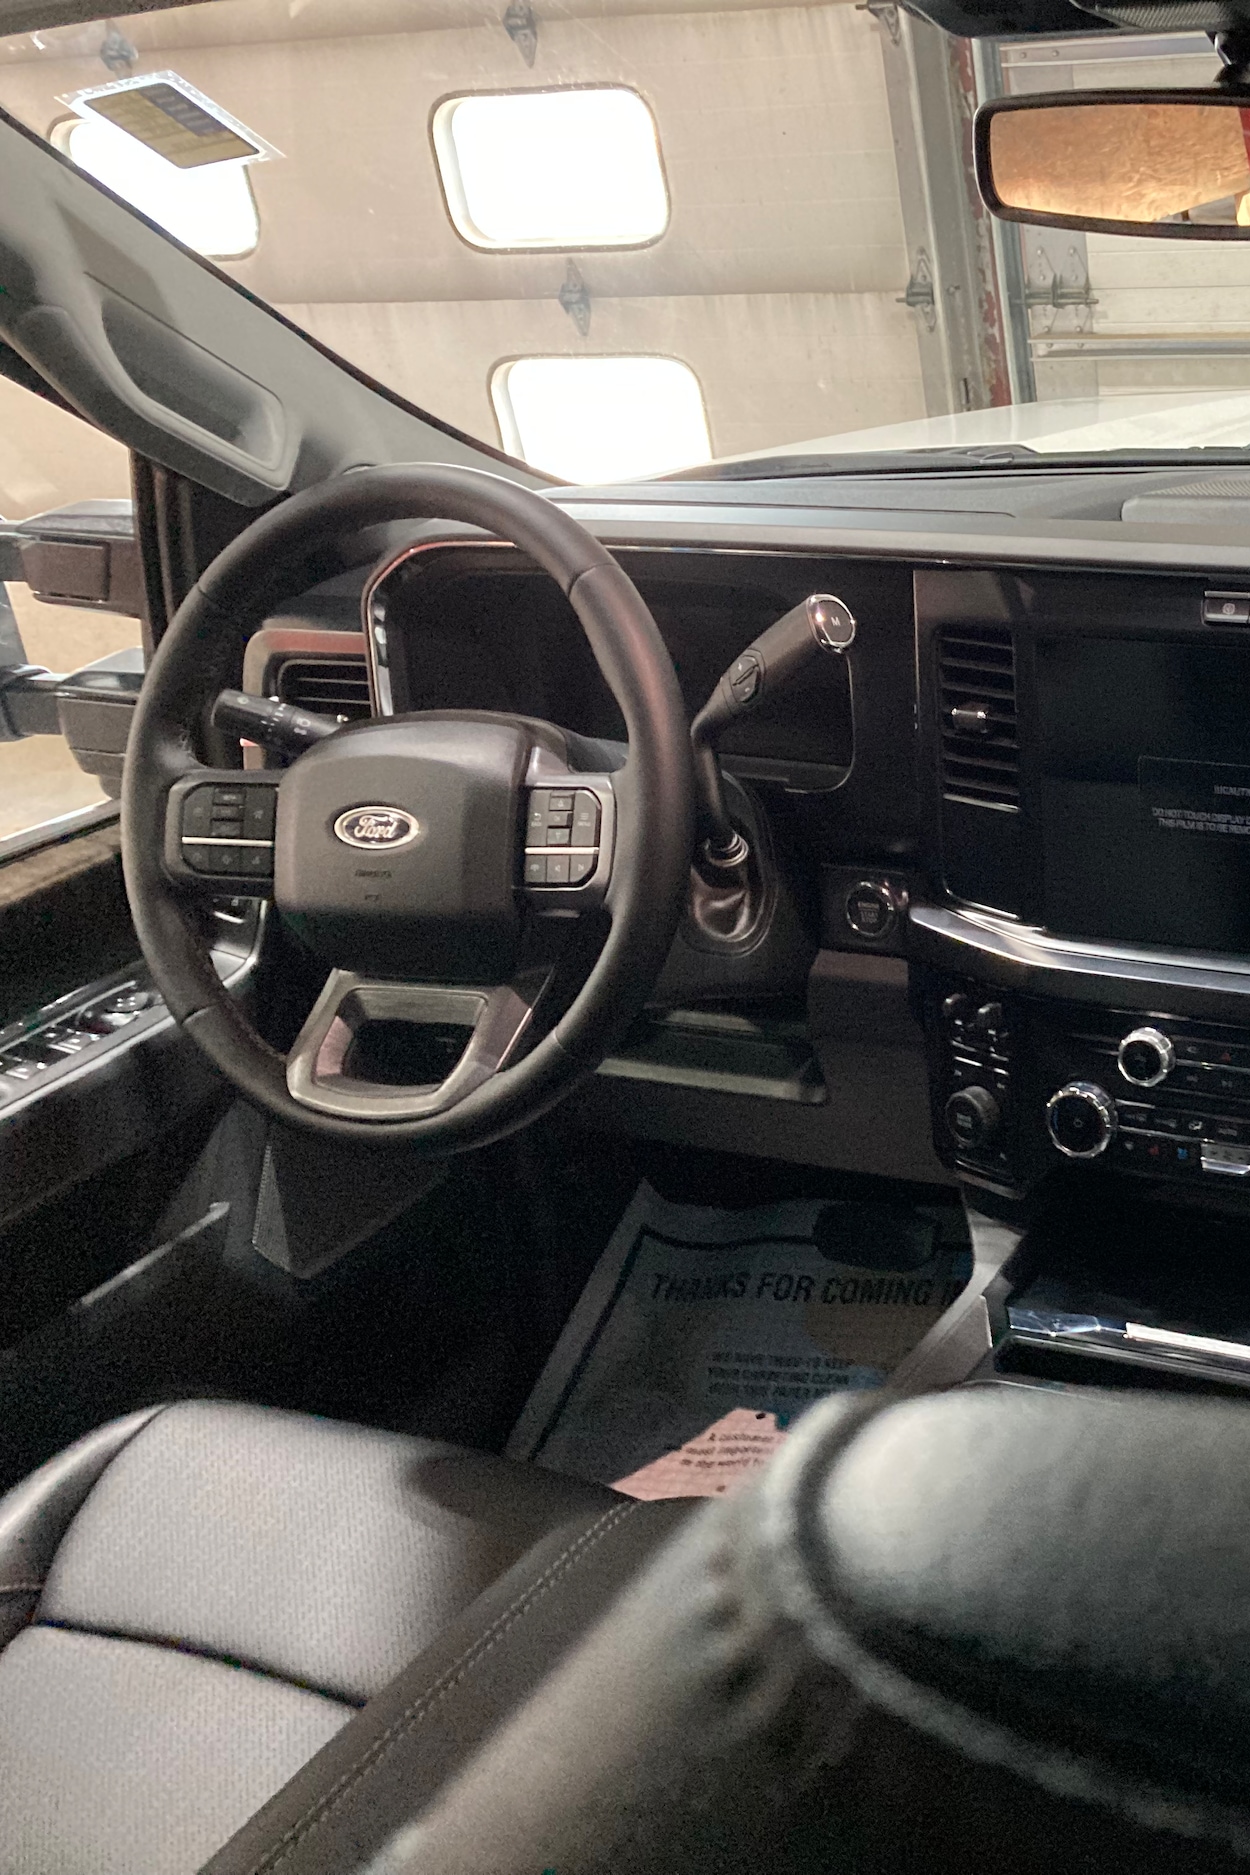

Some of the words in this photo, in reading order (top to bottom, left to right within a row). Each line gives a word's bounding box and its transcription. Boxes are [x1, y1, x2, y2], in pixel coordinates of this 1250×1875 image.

[831, 616, 842, 627] M
[353, 815, 401, 841] Ford
[650, 1271, 749, 1303] THANKS
[754, 1271, 816, 1302] FOR
[822, 1275, 934, 1307] COMING
